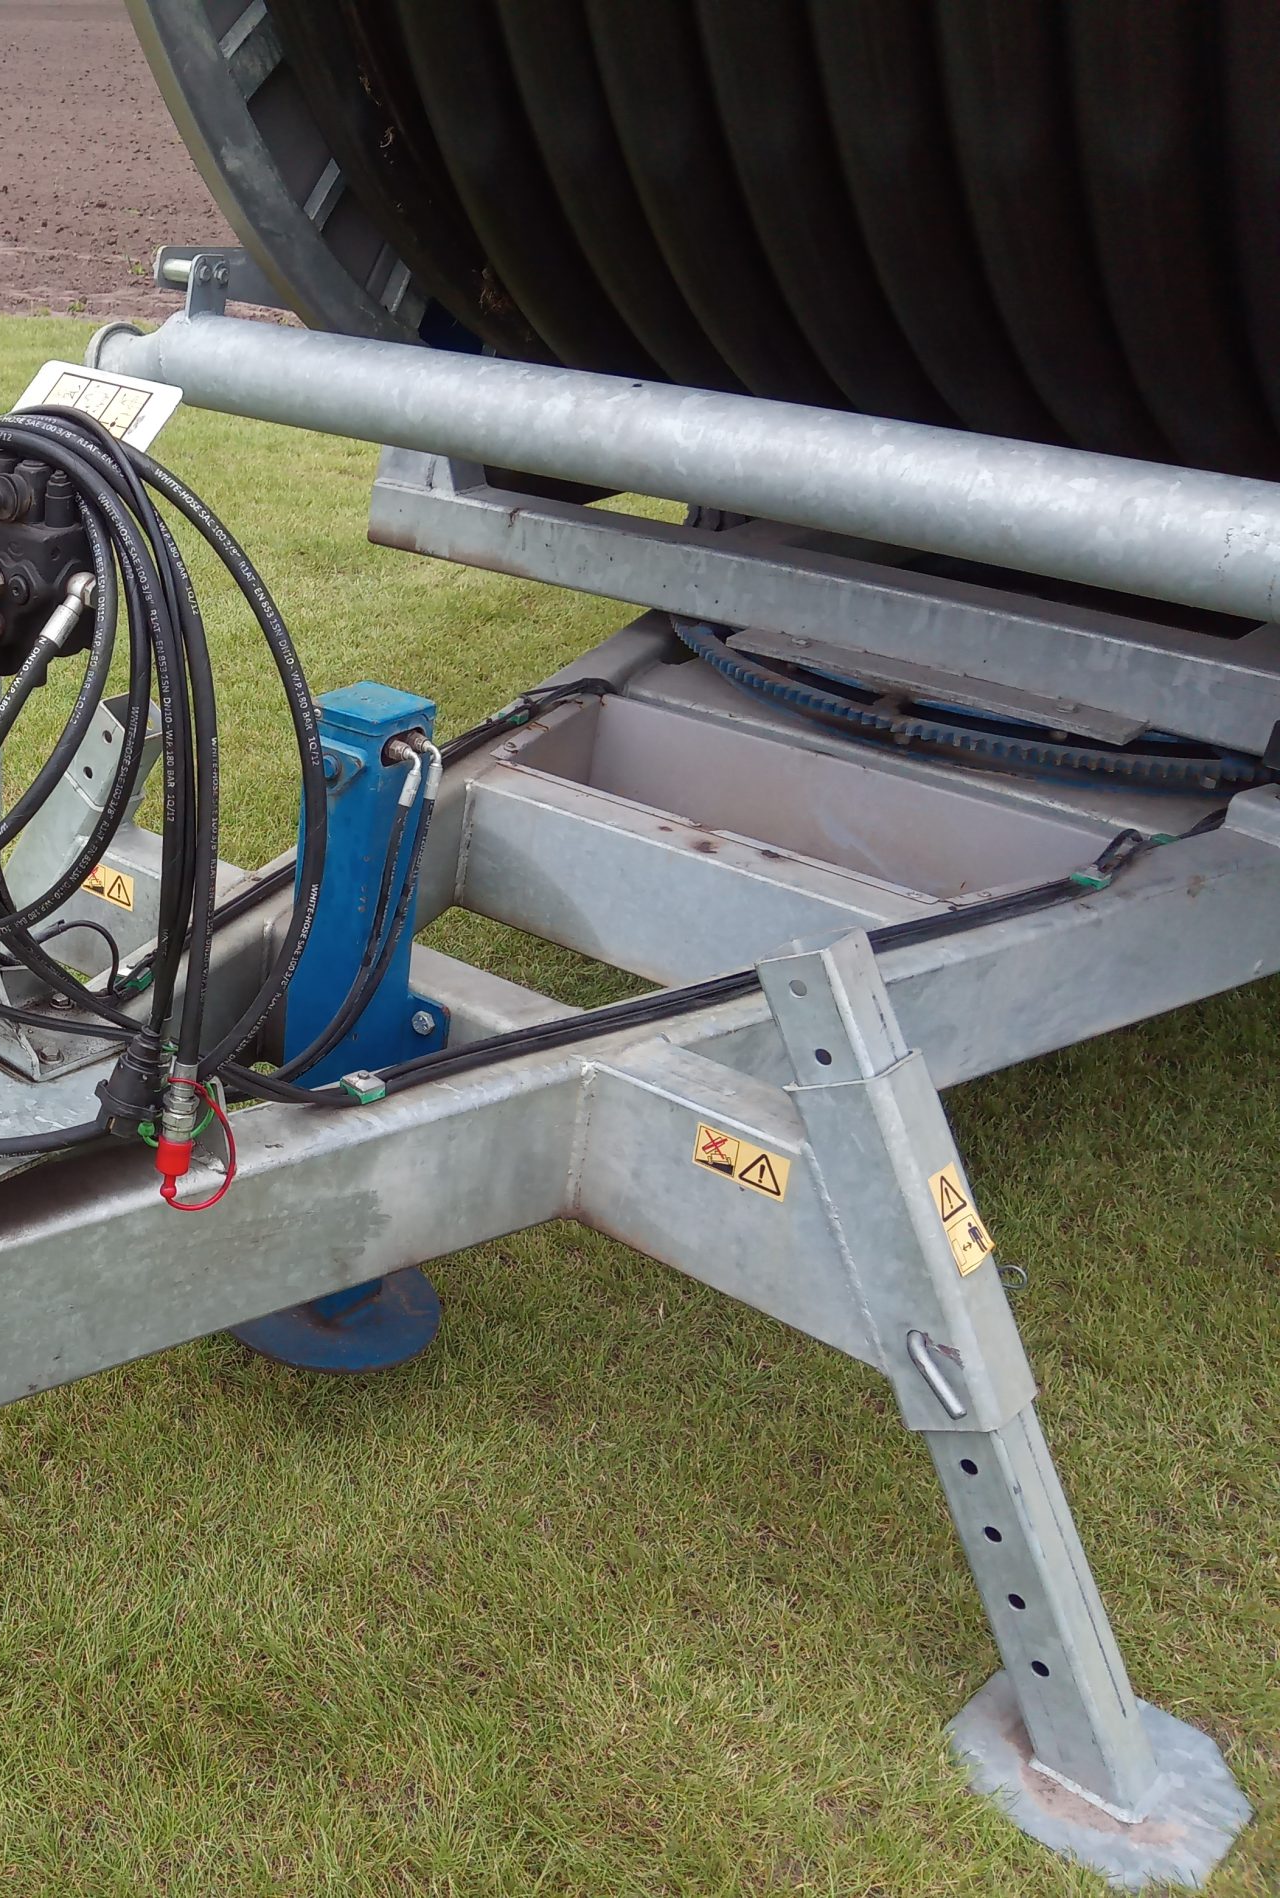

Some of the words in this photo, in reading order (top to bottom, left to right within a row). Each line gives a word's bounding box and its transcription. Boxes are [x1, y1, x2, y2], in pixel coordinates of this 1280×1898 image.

[25, 417, 40, 428] SAE
[40, 421, 57, 433] 100
[100, 453, 113, 465] EN
[154, 468, 203, 513] WHITE-HOSE
[97, 492, 134, 547] WHITE-HOSE
[212, 524, 227, 542] 100
[128, 546, 141, 566] SAE
[167, 540, 180, 559] 180
[135, 563, 148, 584] 100
[253, 587, 266, 602] EN
[261, 601, 275, 619] 853
[22, 647, 41, 673] DN10
[157, 655, 168, 674] 853
[83, 671, 95, 690] BAR
[0, 693, 12, 712] 180
[296, 691, 308, 710] 180
[301, 710, 315, 731] BAR
[166, 748, 175, 767] 180
[307, 735, 320, 767] 1Q/12
[166, 768, 176, 788] BAR
[299, 883, 320, 941] WHITE-HOSE
[287, 956, 301, 972] 100
